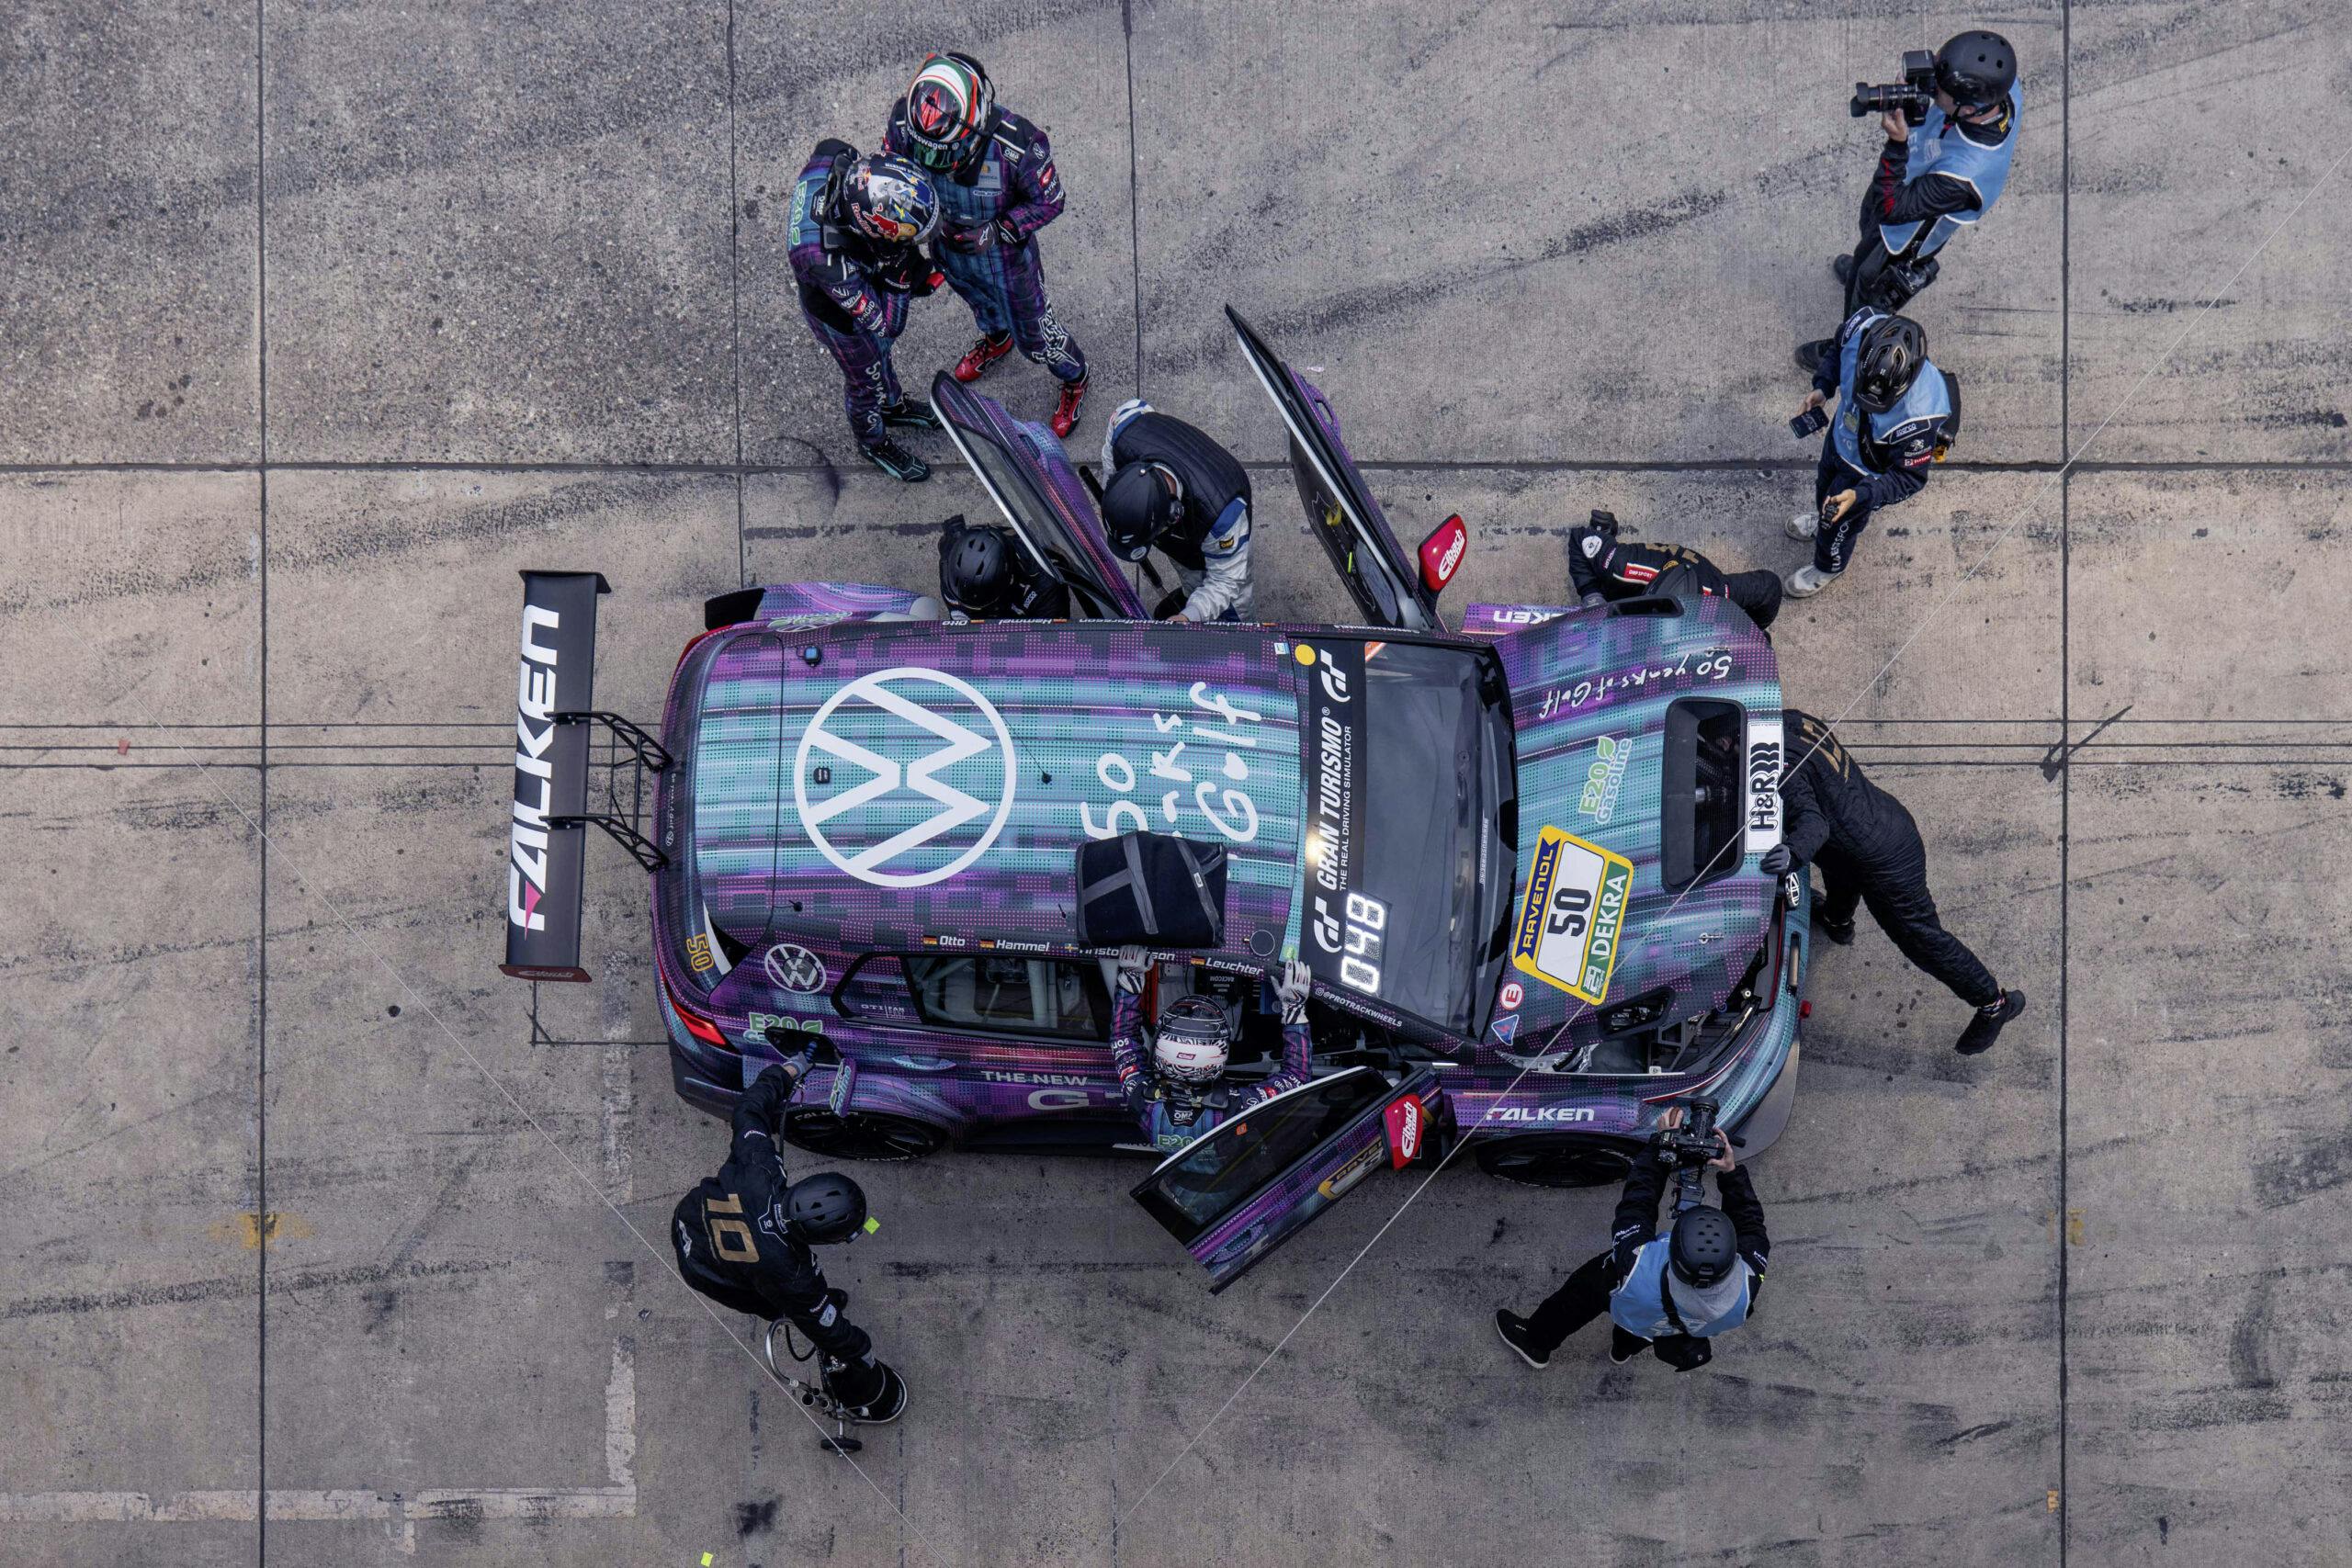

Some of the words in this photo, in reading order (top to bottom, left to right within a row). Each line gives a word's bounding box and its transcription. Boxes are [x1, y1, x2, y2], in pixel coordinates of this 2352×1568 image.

[1697, 655, 1732, 680] 50
[509, 604, 560, 936] FALKEN
[1343, 726, 1351, 788] SIMULATOR
[1577, 763, 1611, 818] E20
[1596, 737, 1634, 825] Gasoline
[1342, 791, 1351, 836] DRIVING
[1317, 820, 1340, 891] GRAN
[1340, 838, 1349, 867] REAL
[1340, 869, 1348, 891] THE
[1522, 849, 1554, 949] RAVENOL
[1547, 886, 1592, 937] 50
[1590, 874, 1627, 957] DEKRA
[685, 932, 715, 972] 50
[939, 935, 966, 947] Otto
[996, 939, 1050, 953] Hammel
[1205, 956, 1264, 976] Leuchter
[980, 1070, 1027, 1084] THE
[1032, 1074, 1089, 1087] NEW
[1486, 1107, 1595, 1122] FALKEN
